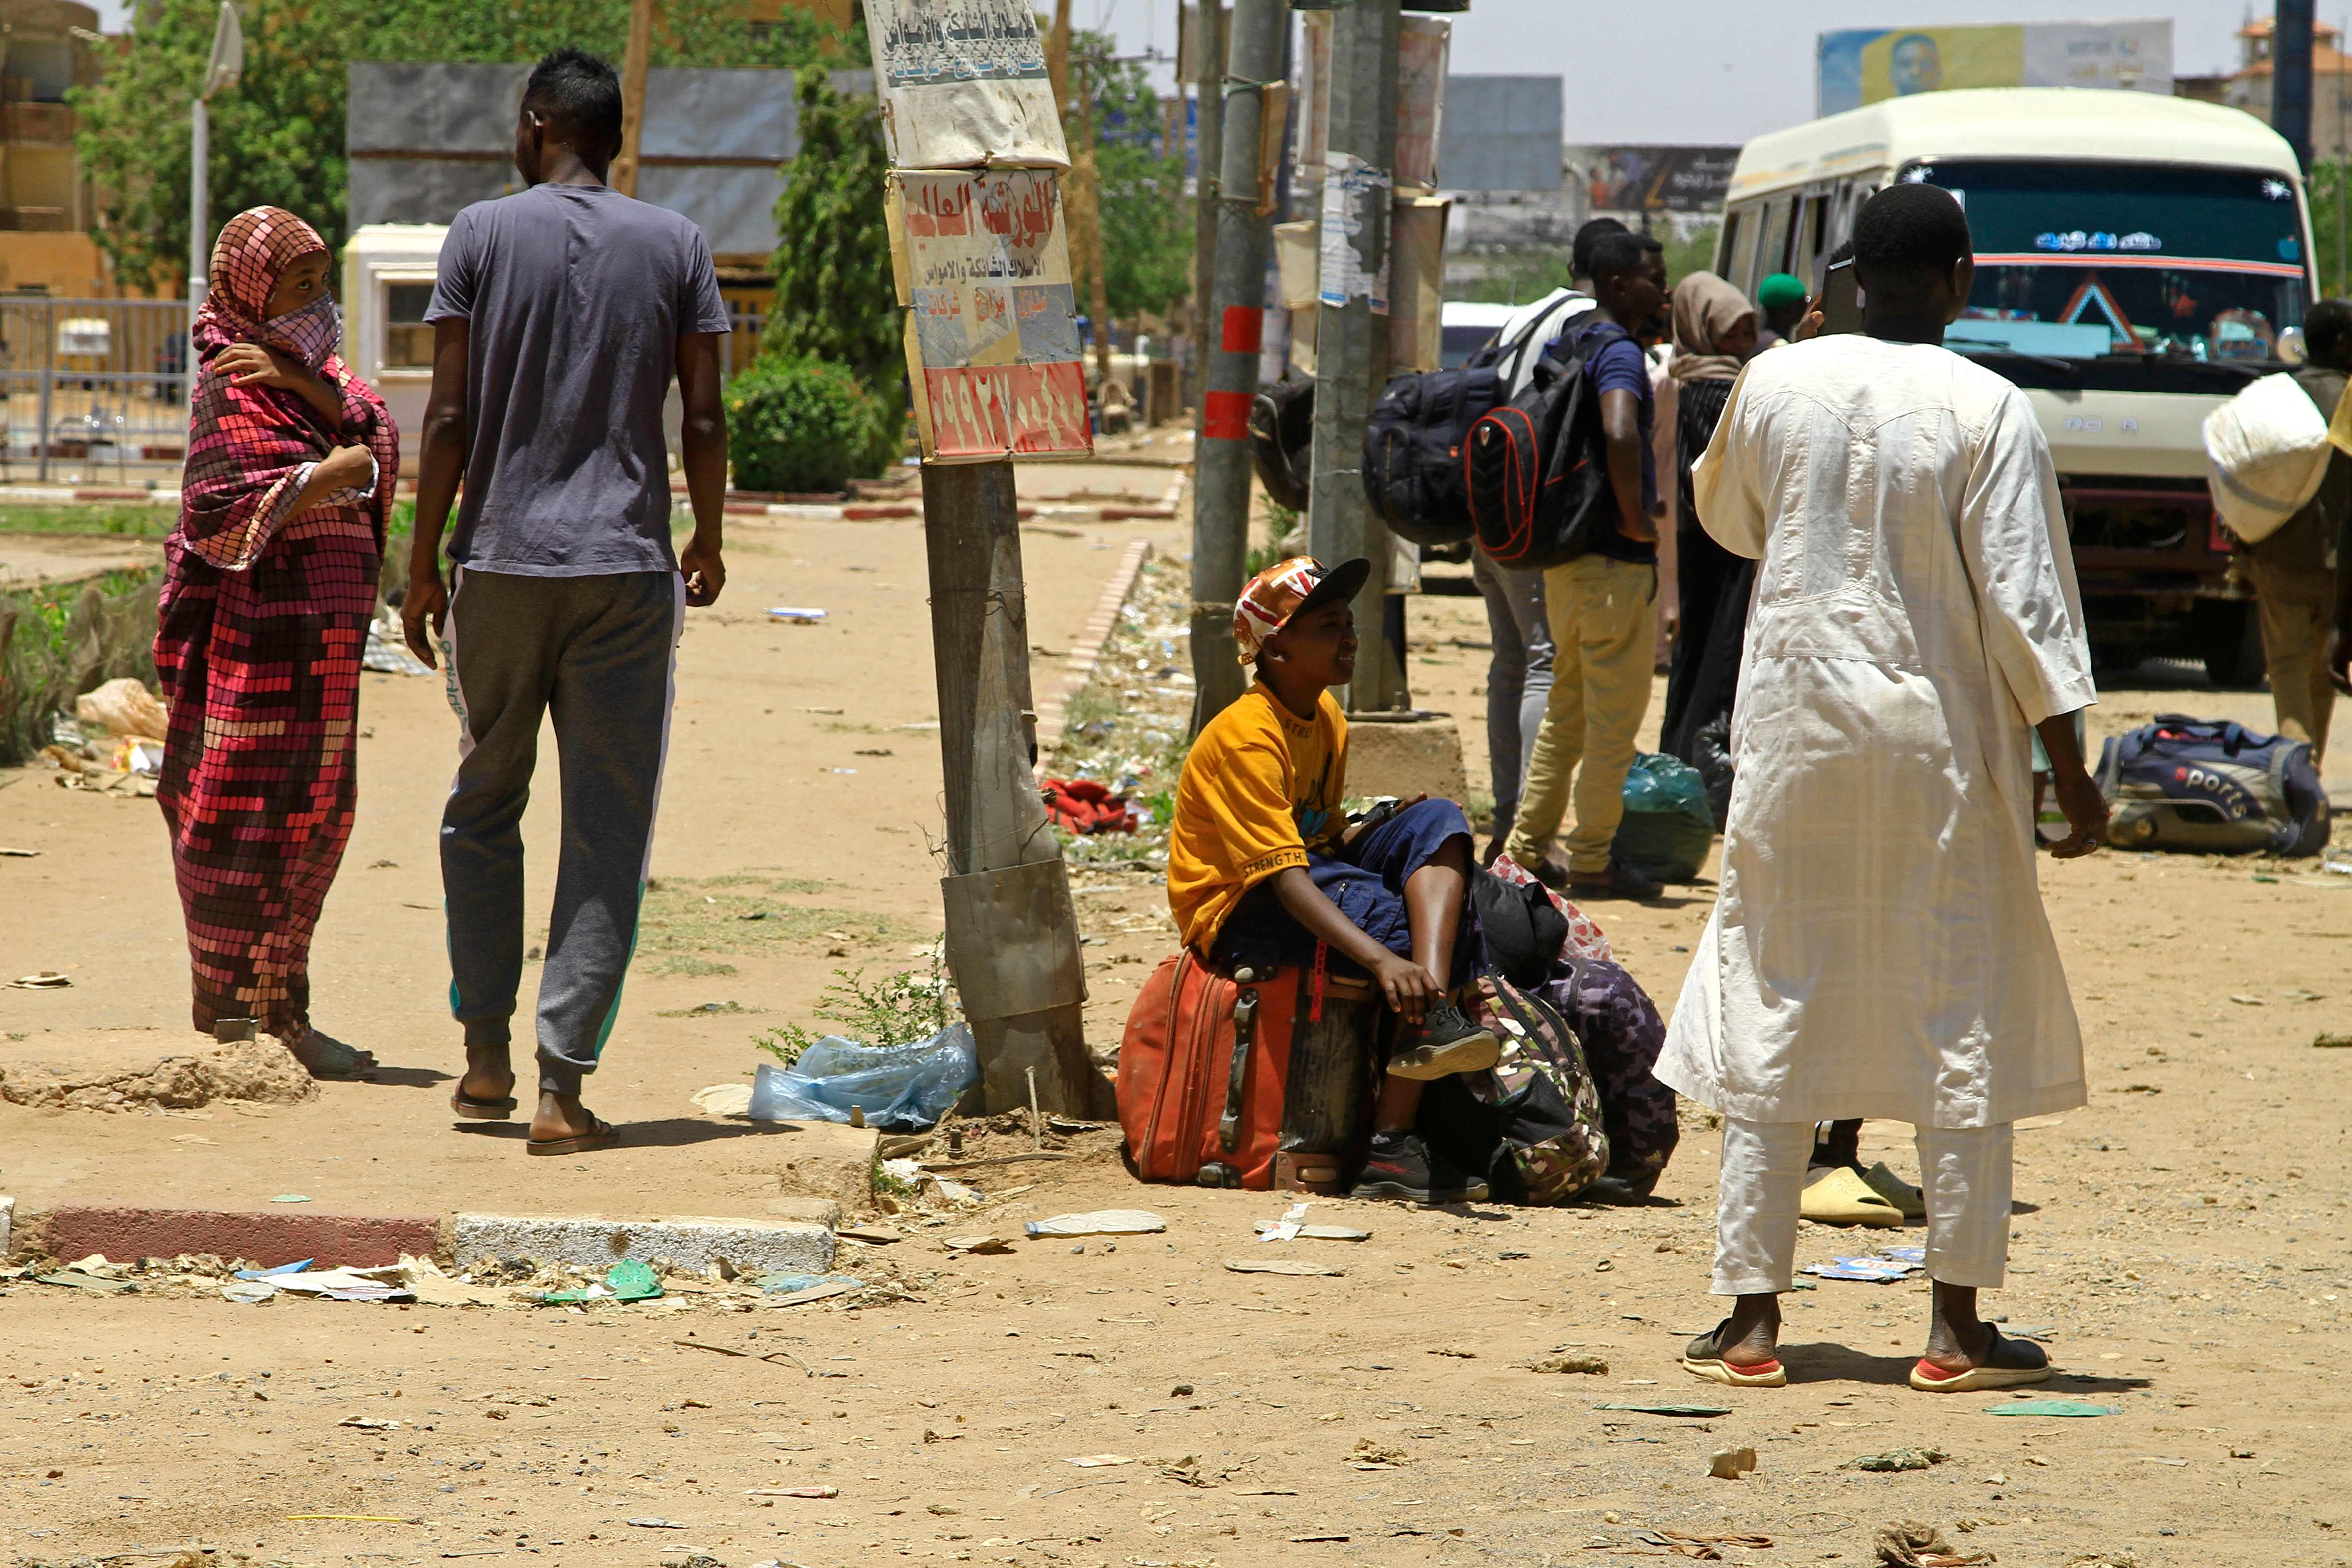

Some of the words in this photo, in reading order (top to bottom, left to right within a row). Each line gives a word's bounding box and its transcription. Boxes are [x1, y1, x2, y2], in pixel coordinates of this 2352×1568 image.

[978, 179, 1053, 248] الورشة
[928, 290, 961, 320] شركات
[1243, 852, 1303, 878] STRENGTH
